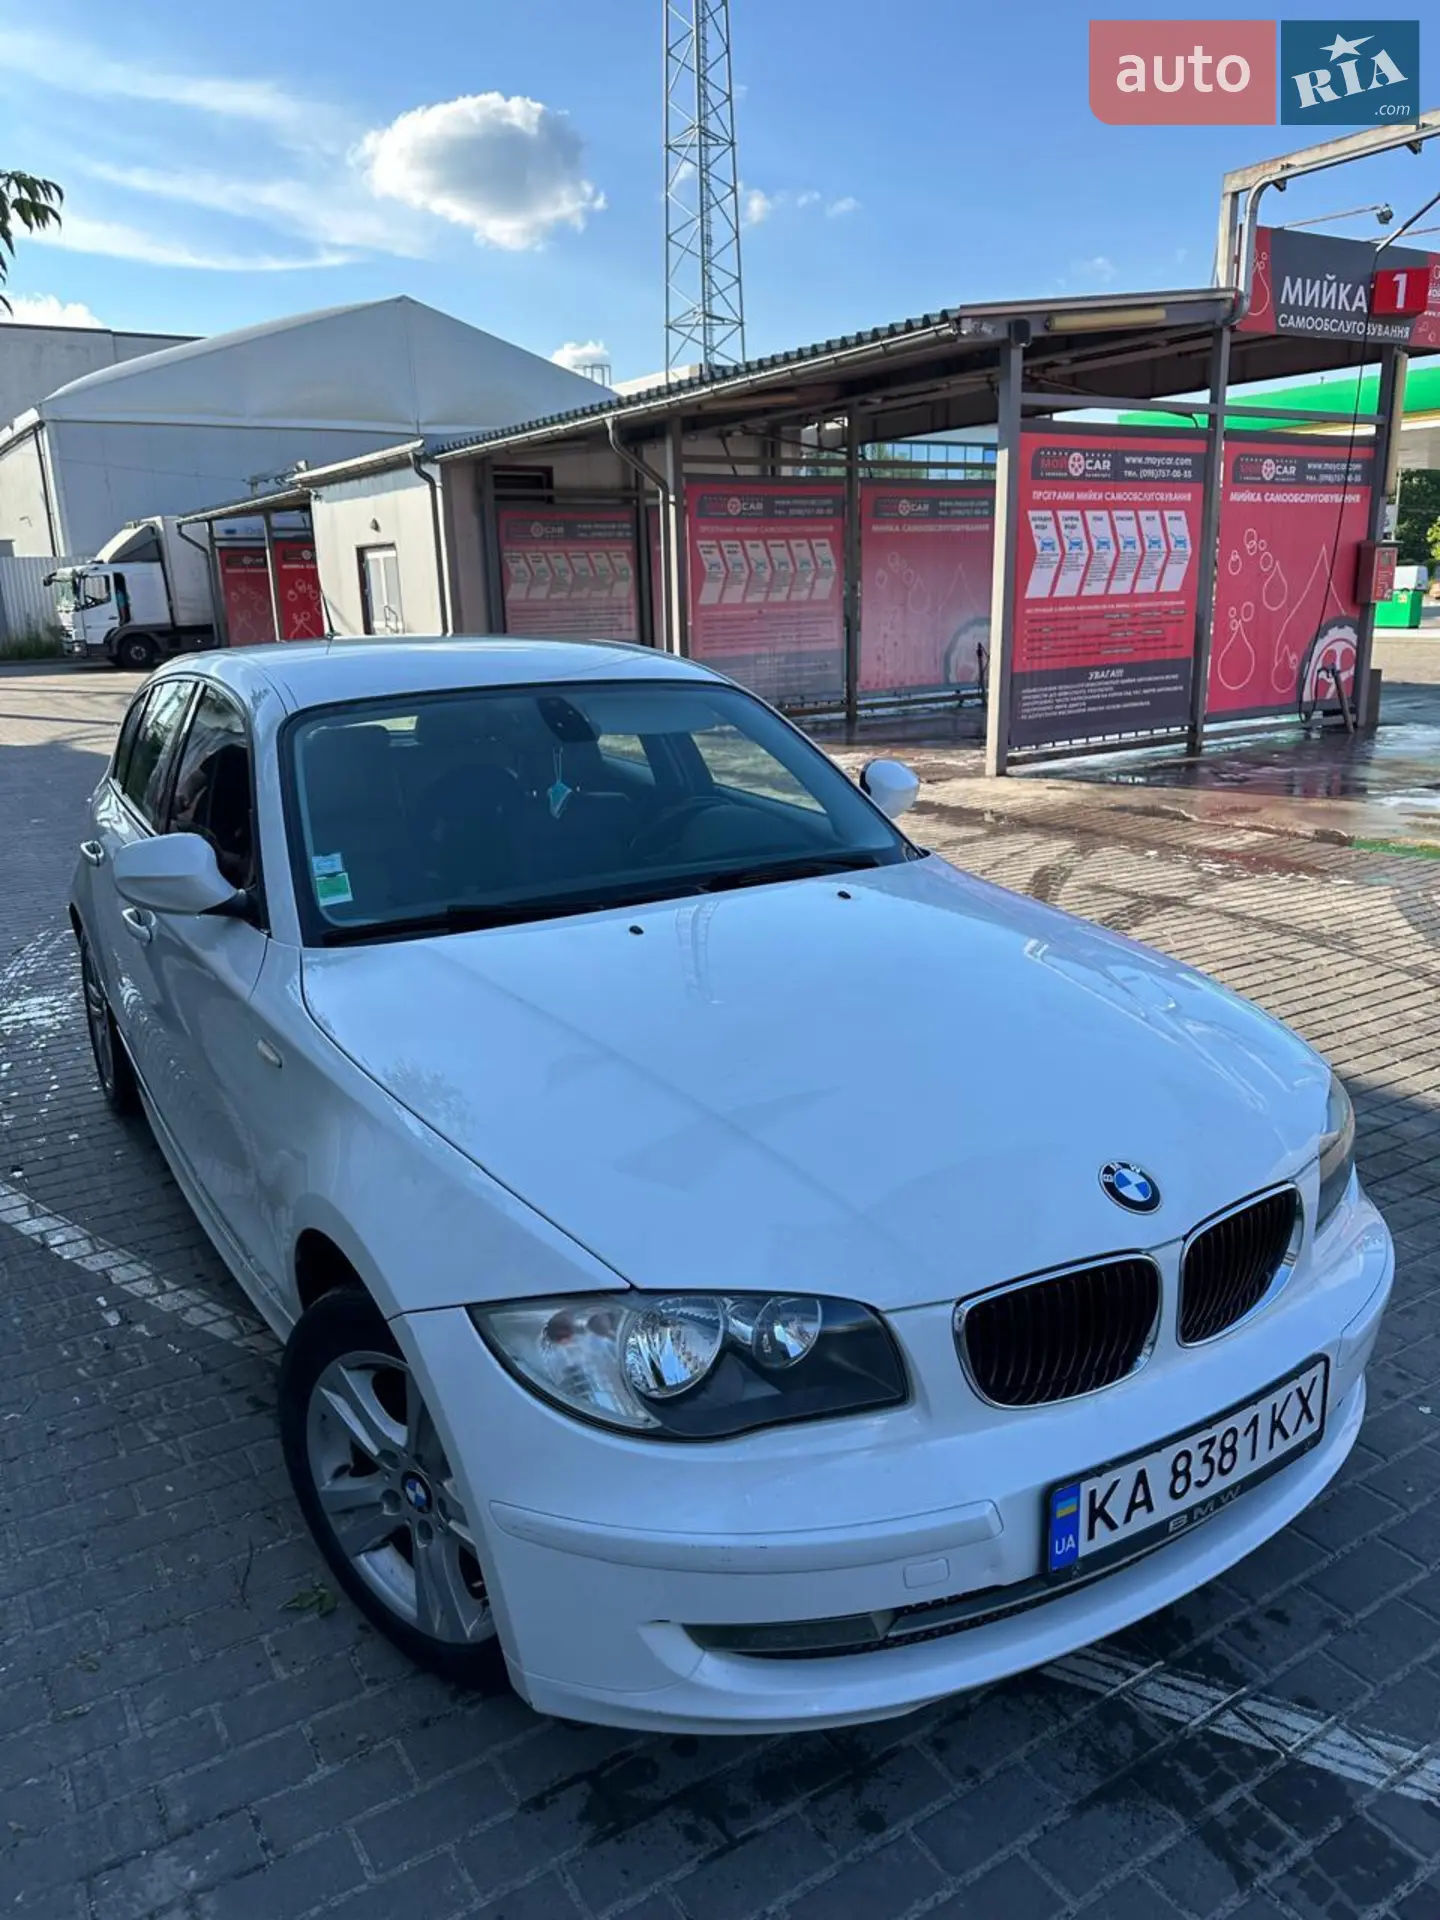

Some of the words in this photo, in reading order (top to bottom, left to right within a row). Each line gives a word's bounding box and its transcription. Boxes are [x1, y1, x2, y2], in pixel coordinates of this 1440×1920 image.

[1280, 273, 1368, 313] МИЙКА
[1392, 272, 1407, 309] 1
[1085, 459, 1111, 471] CAR
[1124, 456, 1192, 467] www.moycar.com
[1307, 463, 1362, 472] www.moycarcom
[1275, 465, 1297, 476] CAR
[1032, 490, 1075, 501] ПРОГРАМИ
[1229, 489, 1262, 502] МИЙКА
[1087, 1467, 1154, 1542] KA
[1169, 1412, 1260, 1501] 8381
[1167, 1484, 1242, 1533] BMW
[1055, 1533, 1076, 1555] UA
